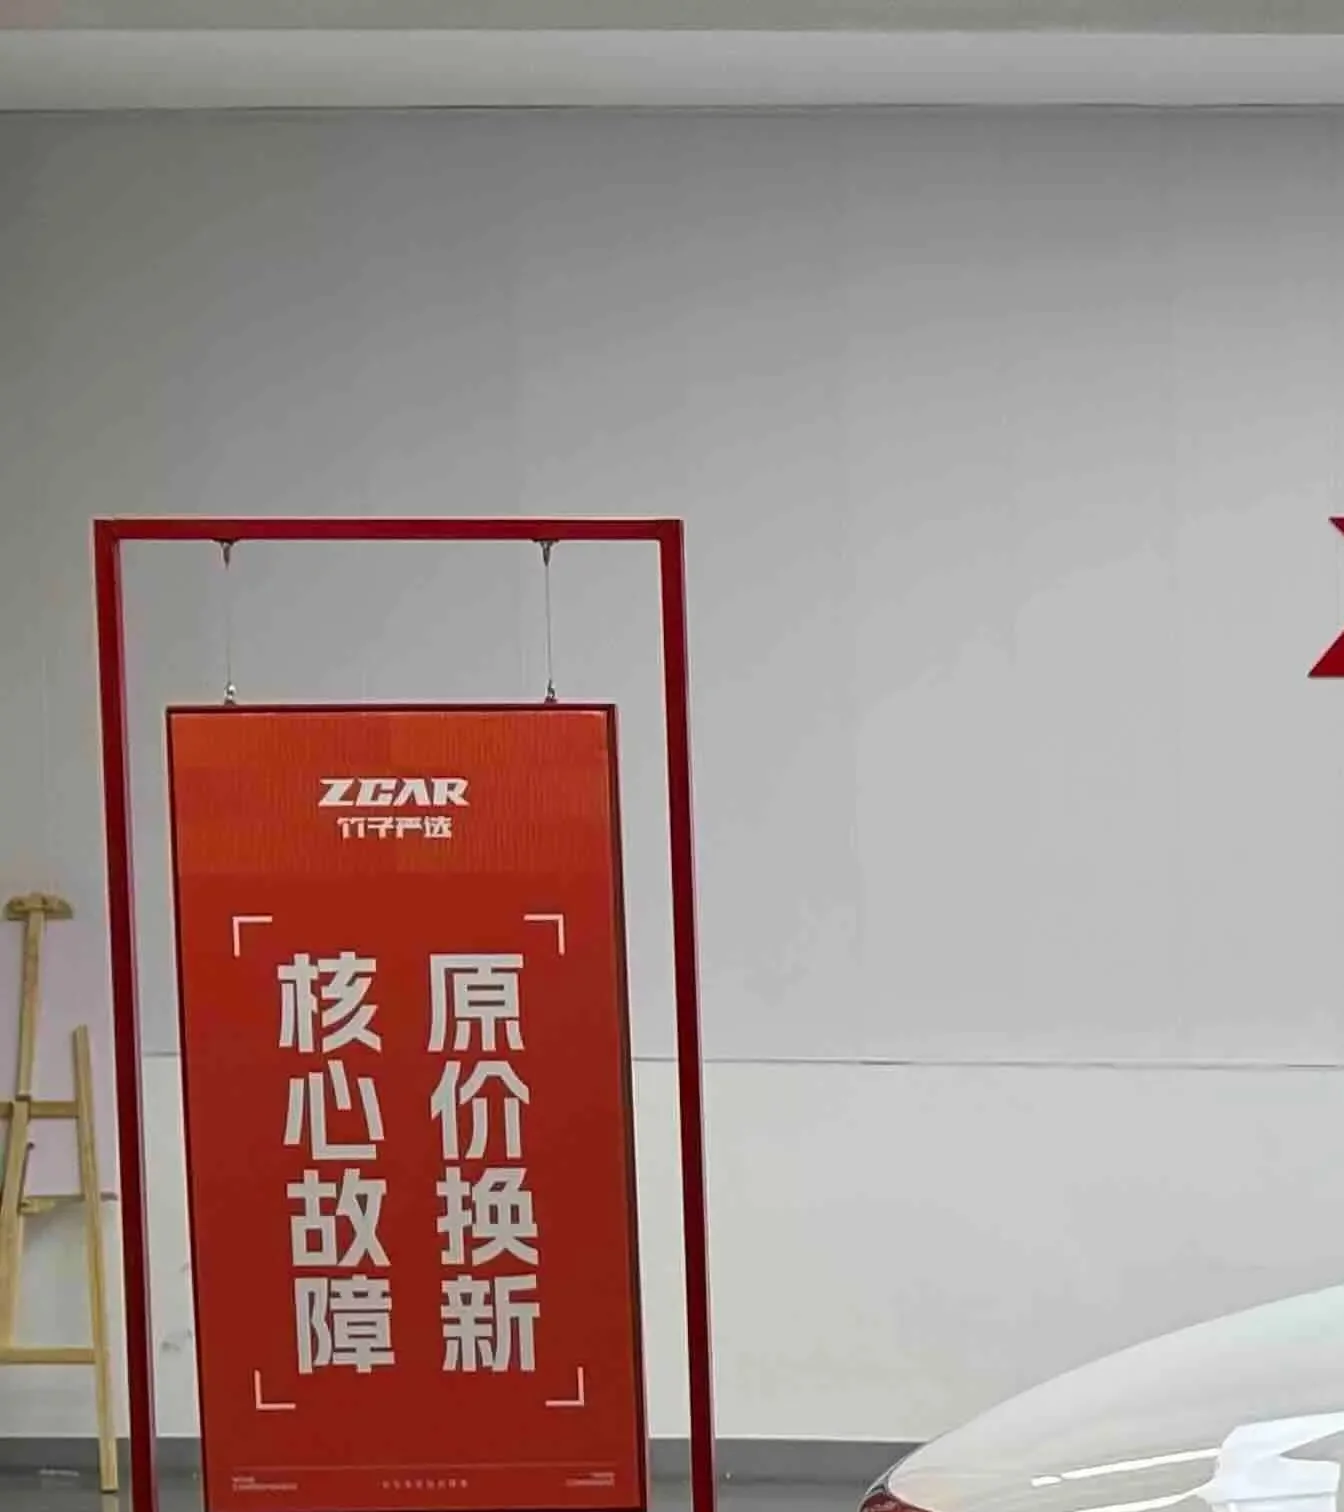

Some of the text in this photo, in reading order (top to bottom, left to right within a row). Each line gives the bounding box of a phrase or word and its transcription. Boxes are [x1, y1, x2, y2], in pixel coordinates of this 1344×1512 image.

[318, 777, 470, 807] ZCAR
[336, 815, 453, 839] 竹子严选
[277, 951, 396, 1375] 核心故障
[427, 952, 541, 1373] 原价换新
